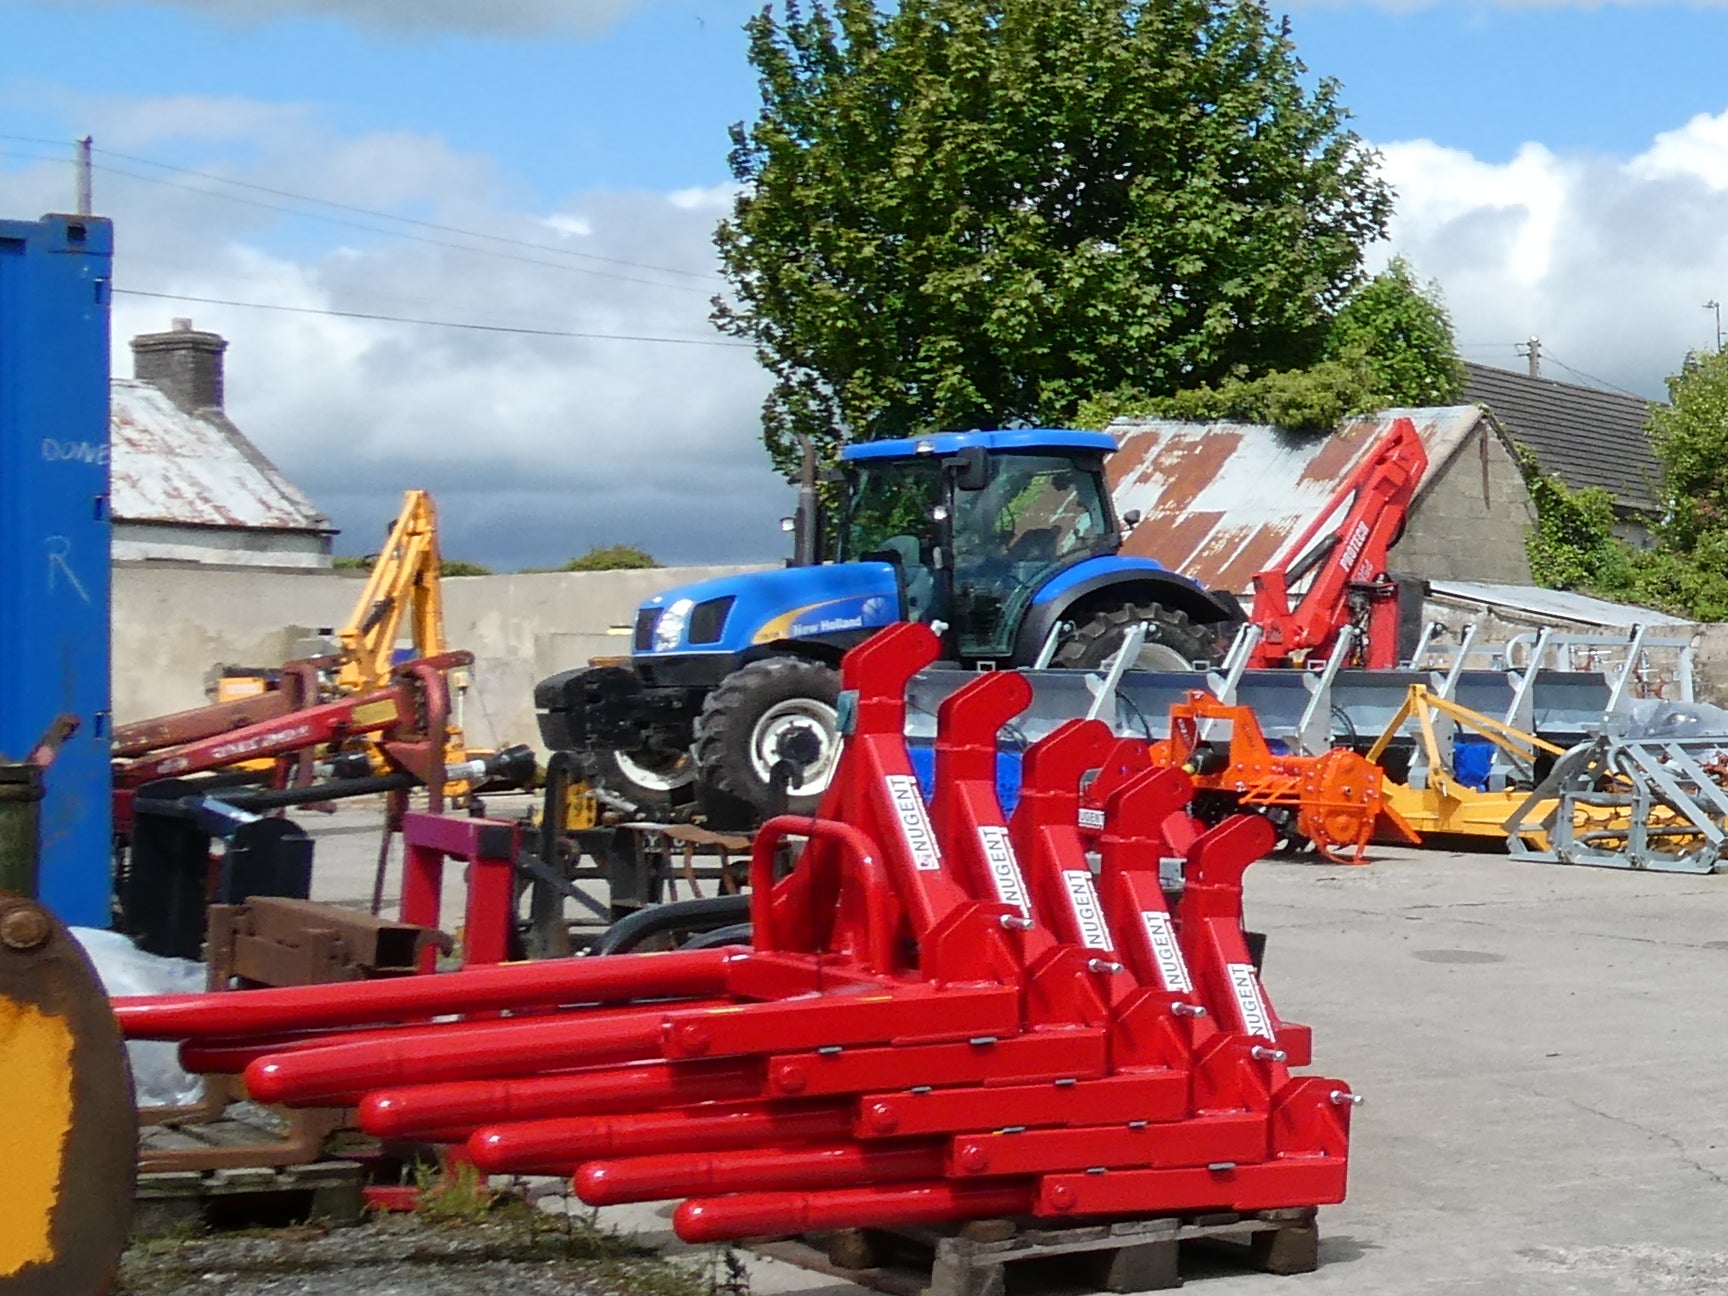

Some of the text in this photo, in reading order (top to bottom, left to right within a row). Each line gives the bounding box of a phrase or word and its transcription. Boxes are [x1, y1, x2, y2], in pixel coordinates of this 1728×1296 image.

[793, 623, 819, 637] New
[820, 616, 863, 631] Holland
[890, 778, 930, 857] NUGENT
[982, 827, 1020, 902] NUGENT
[1067, 872, 1105, 945] NUGENT
[1146, 914, 1184, 985] NUGENT
[1233, 966, 1265, 1036] NUGENT
